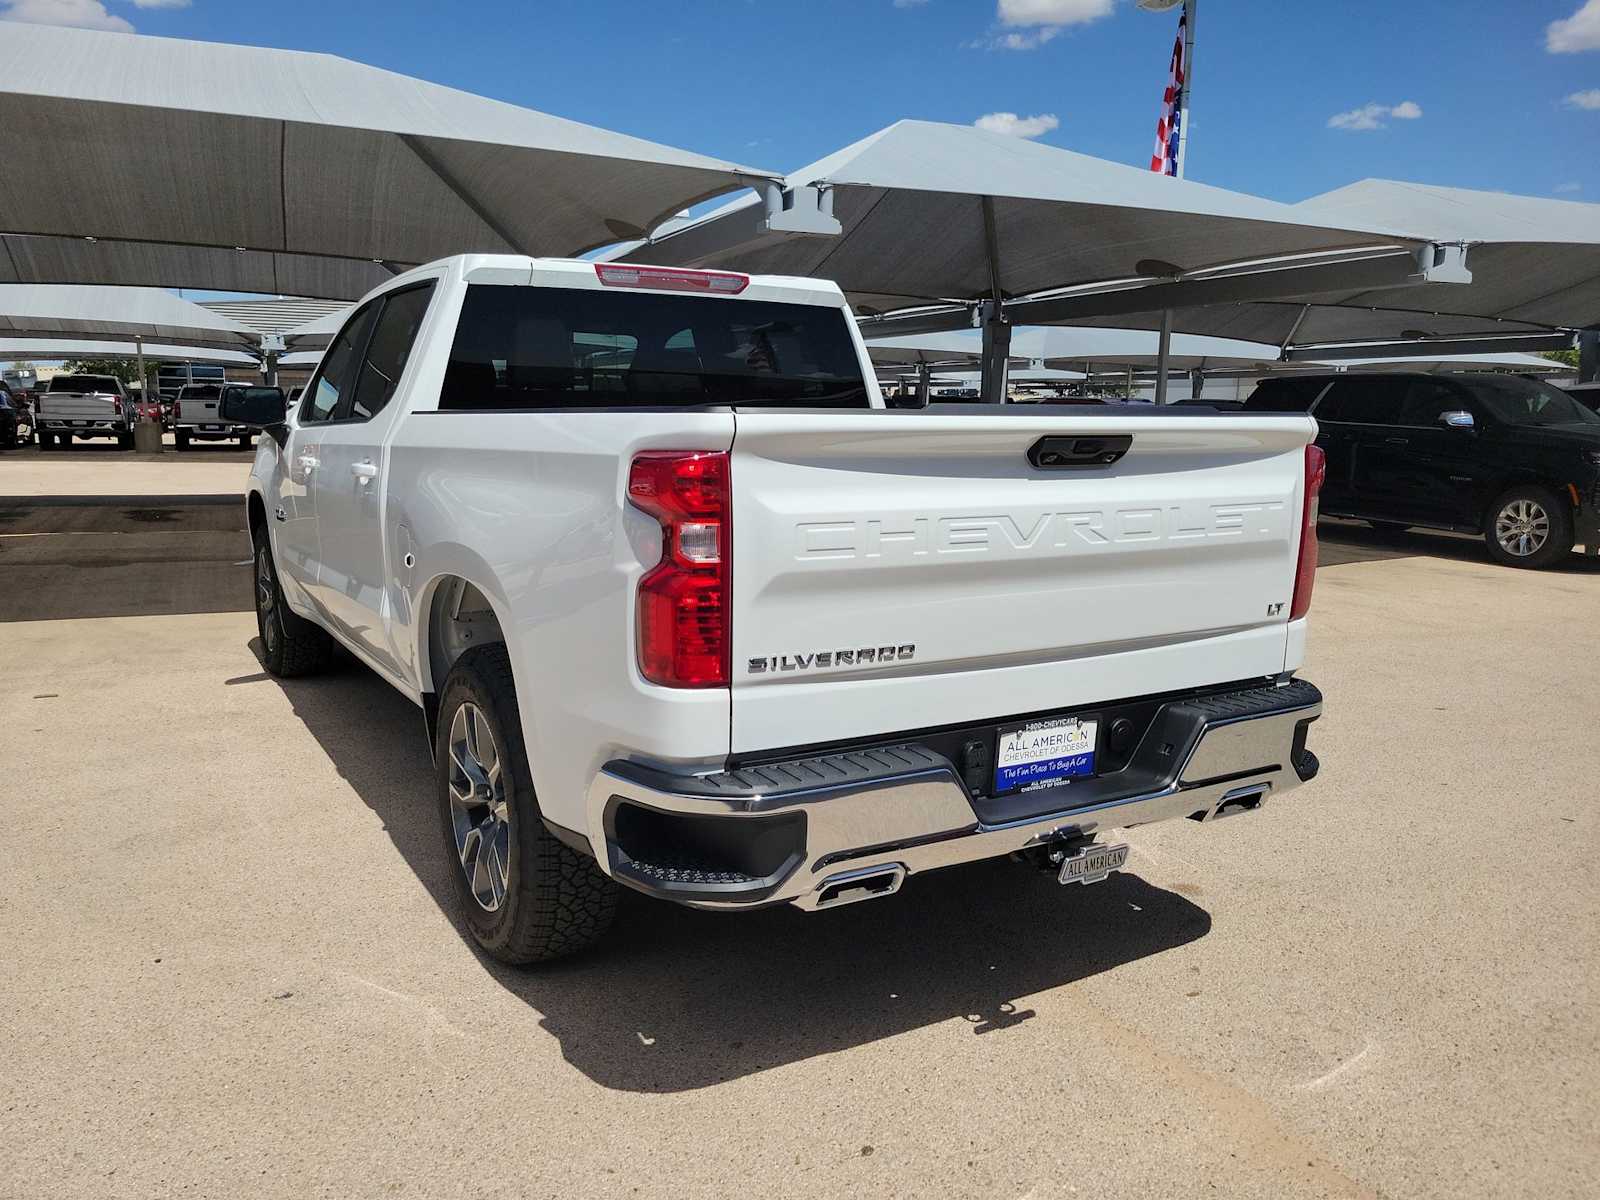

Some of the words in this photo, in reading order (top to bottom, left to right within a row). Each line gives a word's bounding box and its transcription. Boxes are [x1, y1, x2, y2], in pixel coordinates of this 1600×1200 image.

[795, 500, 1284, 562] CHEVROLET
[1267, 602, 1285, 617] LT
[748, 644, 916, 674] SILVERADO
[1003, 748, 1049, 762] CHEVROLET
[1050, 746, 1060, 755] OF
[1061, 741, 1089, 753] ODESSA
[1006, 740, 1028, 752] ALL
[1003, 768, 1016, 779] The
[1016, 767, 1030, 777] Fun
[1030, 764, 1047, 776] Place
[1048, 761, 1056, 771] To
[1057, 760, 1070, 771] Buy
[1069, 758, 1076, 768] A
[1076, 756, 1088, 766] Car
[1068, 861, 1082, 876] ALL
[1082, 849, 1123, 872] AMERICAN
